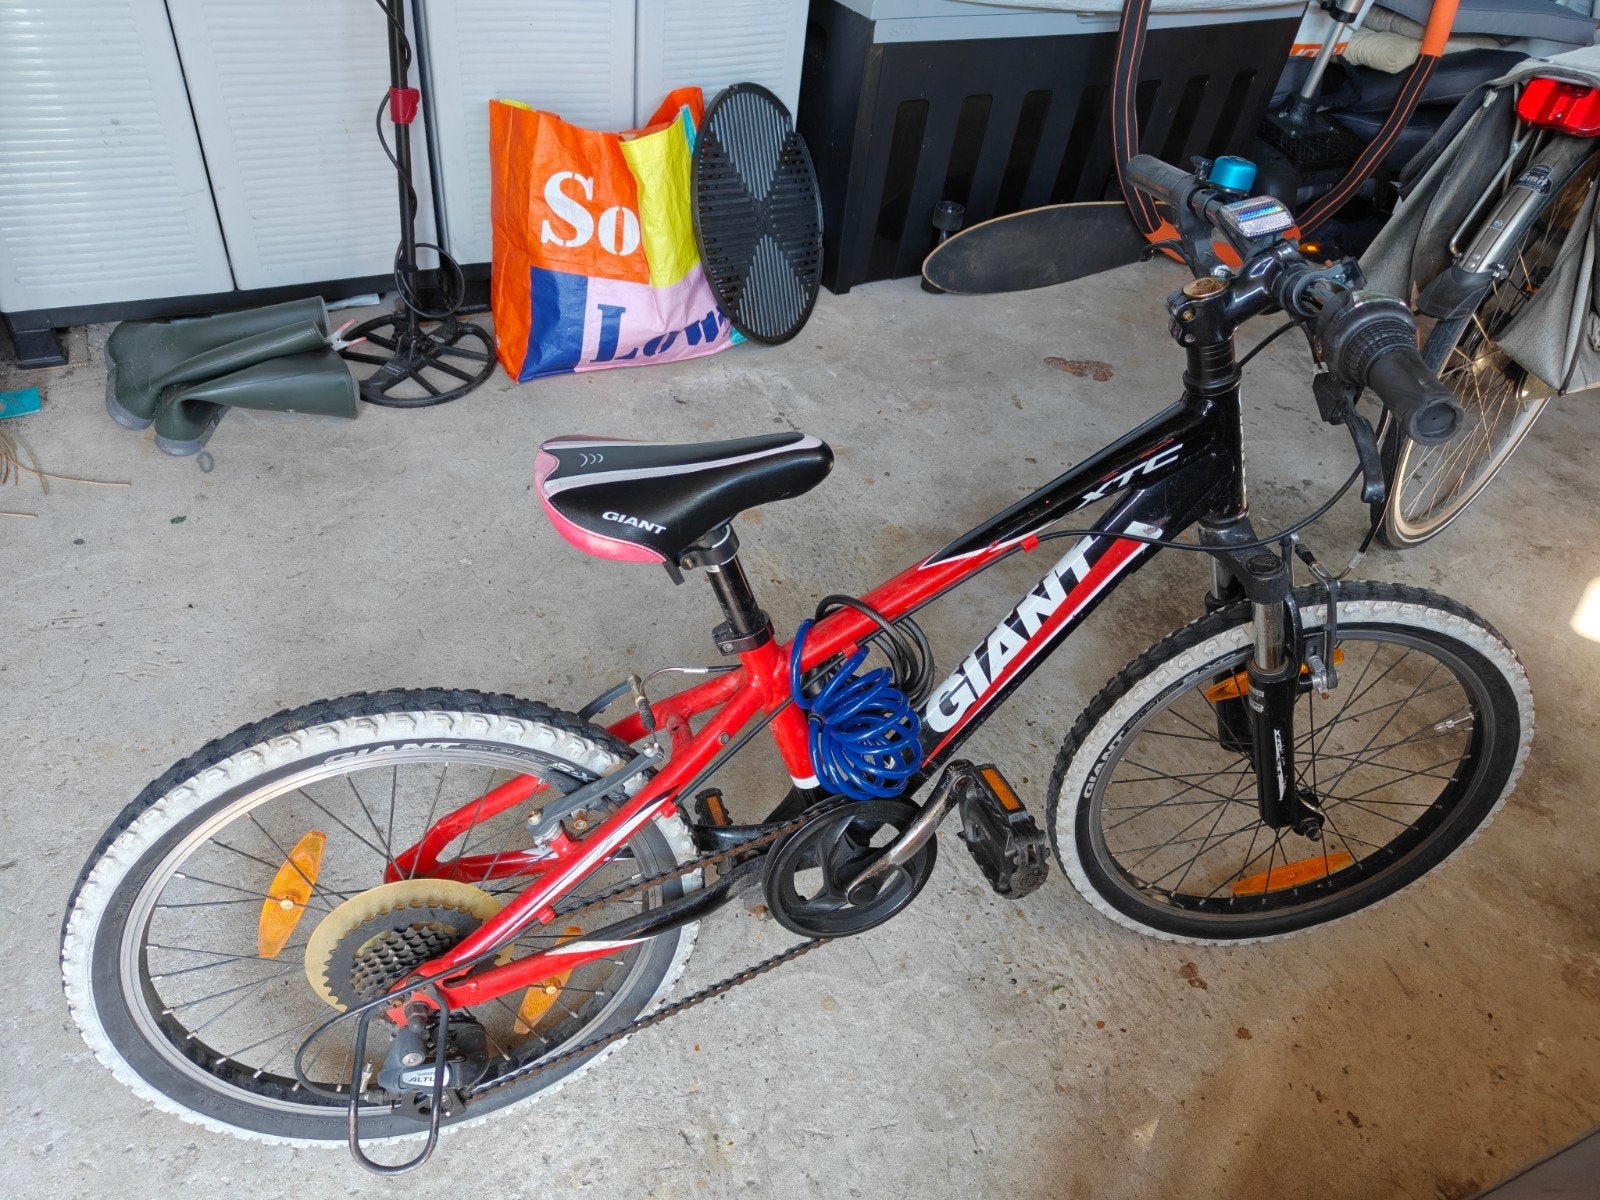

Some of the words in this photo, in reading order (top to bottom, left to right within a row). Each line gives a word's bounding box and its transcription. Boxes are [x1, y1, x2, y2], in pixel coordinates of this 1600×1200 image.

[540, 171, 642, 257] So
[1081, 443, 1184, 501] XTC
[602, 511, 667, 535] GIANT
[926, 534, 1096, 732] GIANT
[323, 742, 461, 765] GIANT
[1083, 730, 1125, 799] GIANT
